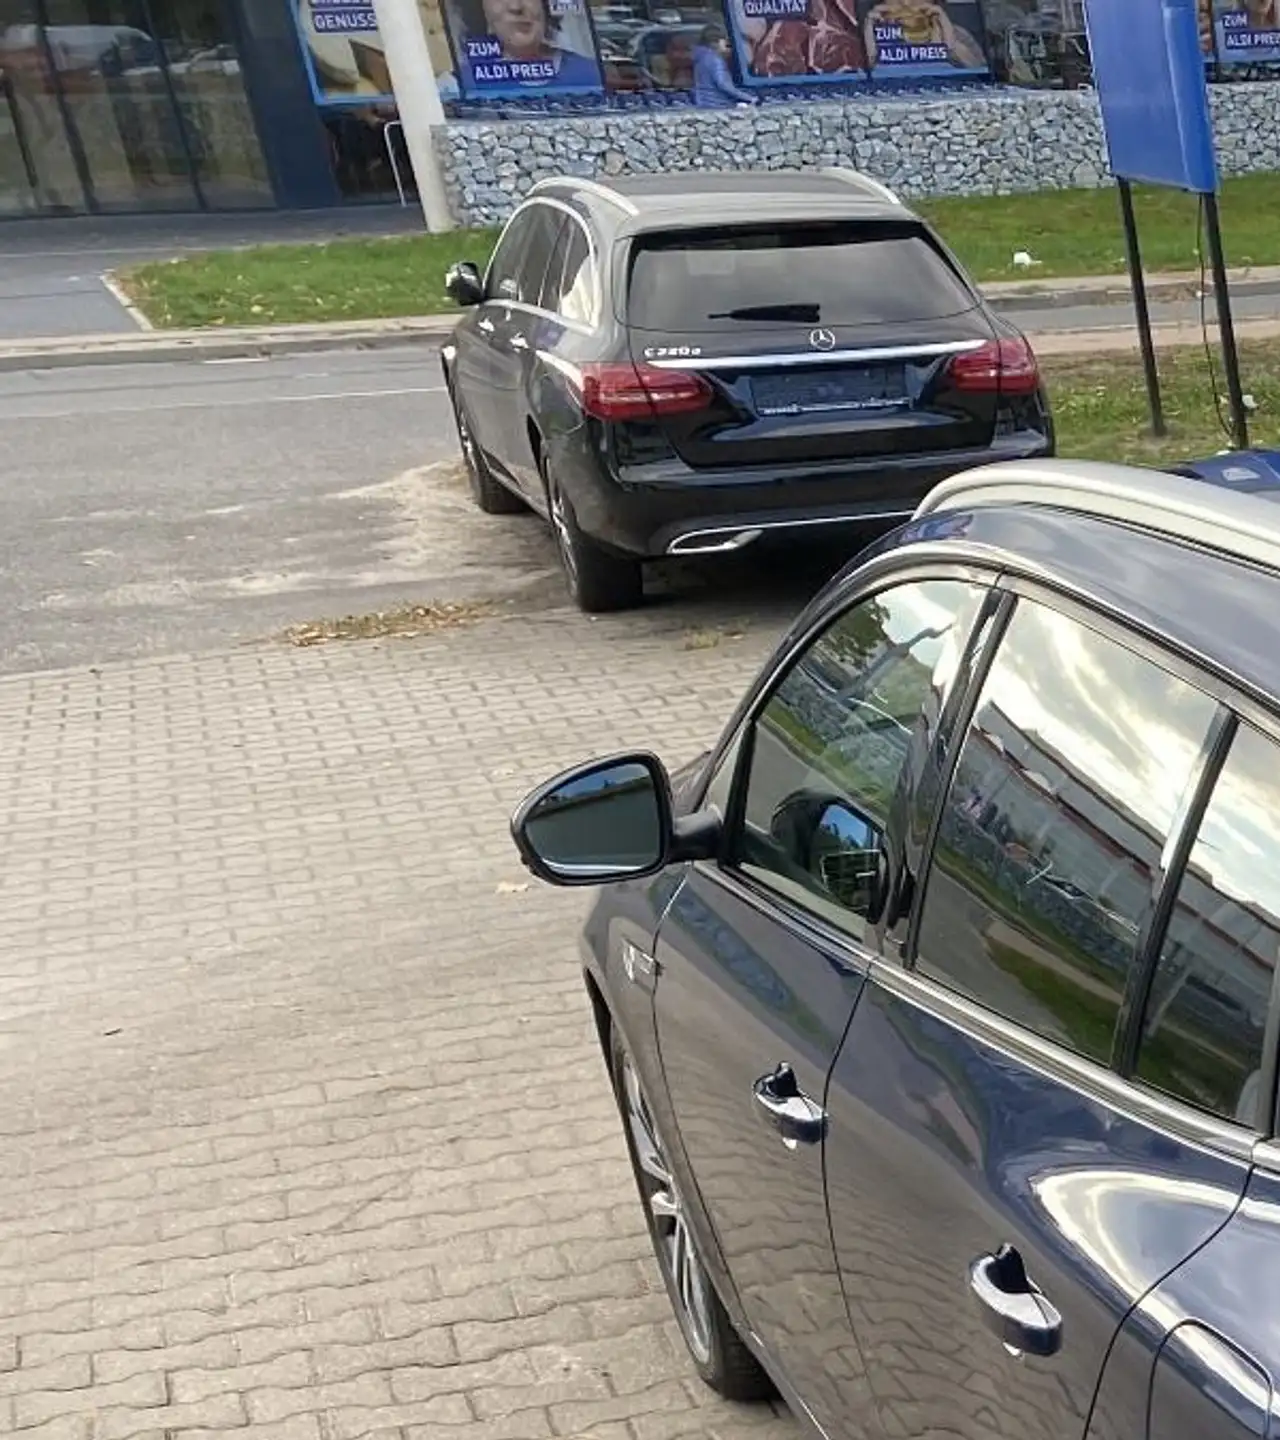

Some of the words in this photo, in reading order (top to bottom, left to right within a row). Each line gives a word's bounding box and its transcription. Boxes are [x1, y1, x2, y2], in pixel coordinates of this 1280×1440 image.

[1223, 13, 1247, 27] ZUM
[875, 27, 903, 40] ZUM
[1227, 33, 1251, 46] ALDI
[467, 42, 500, 57] ZUM
[880, 47, 908, 61] ALDI
[911, 45, 947, 60] PREIS
[475, 64, 509, 80] ALDI
[512, 62, 554, 79] PREIS
